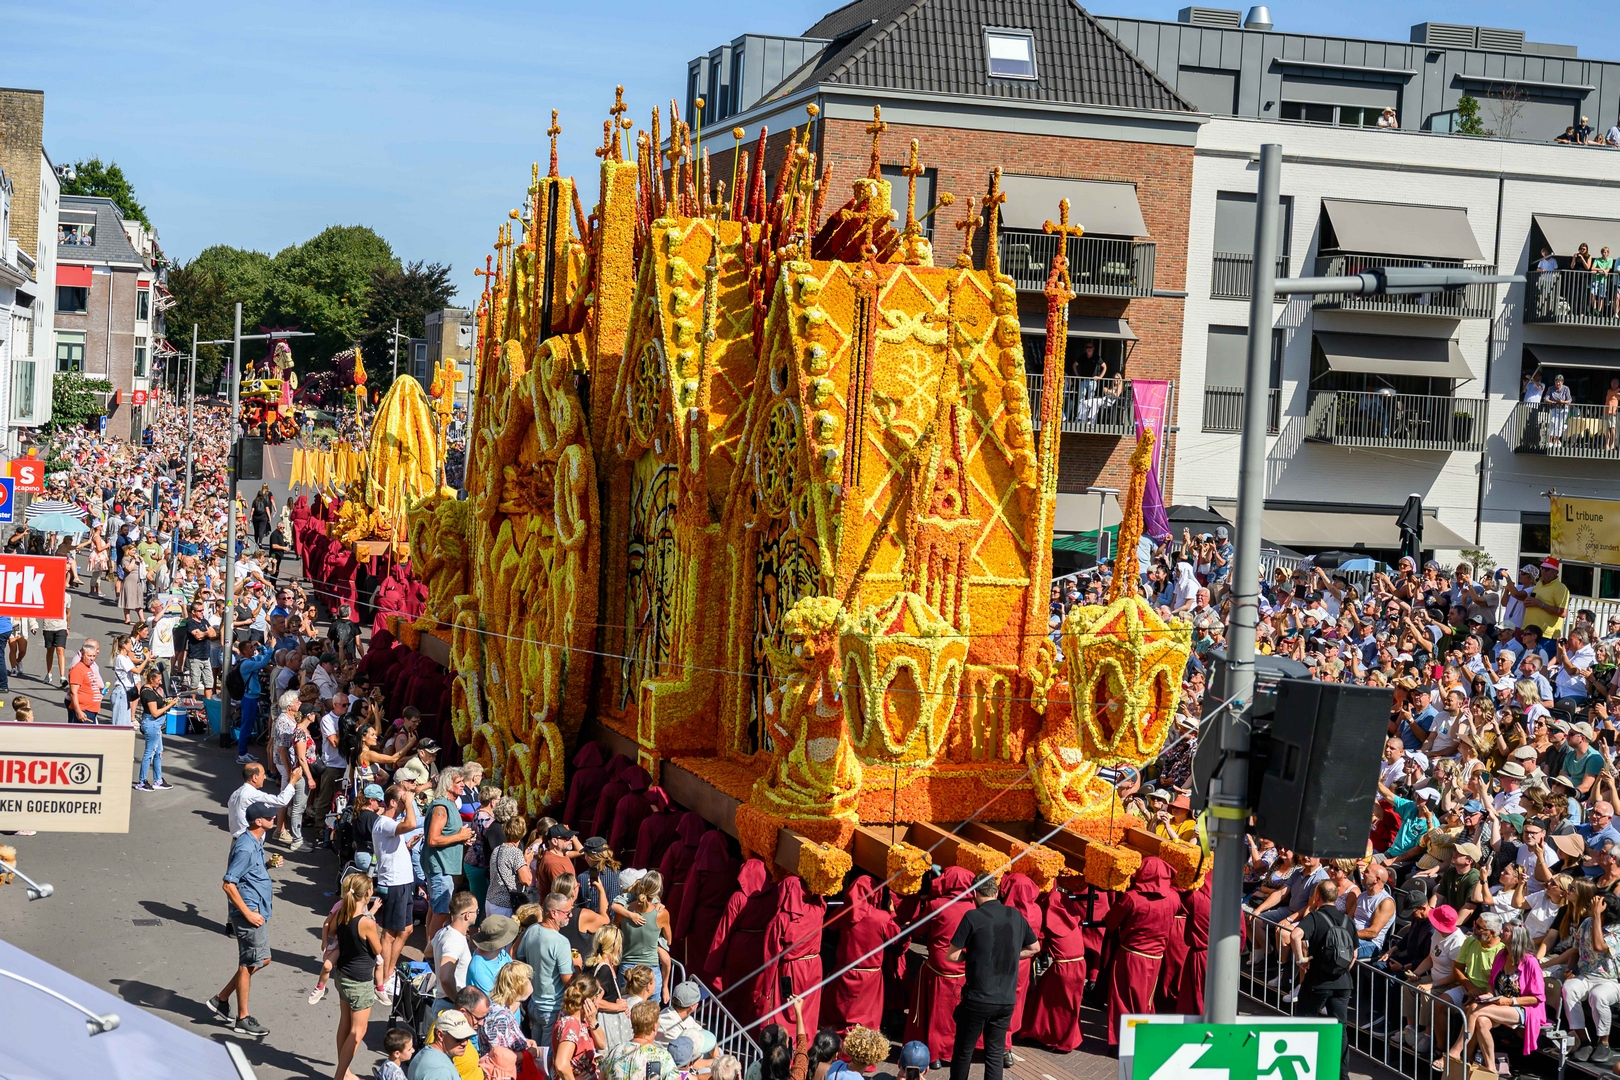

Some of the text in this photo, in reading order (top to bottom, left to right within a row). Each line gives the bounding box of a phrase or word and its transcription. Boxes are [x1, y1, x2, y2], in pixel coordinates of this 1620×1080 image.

[20, 466, 35, 485] S
[1576, 511, 1604, 522] tribune
[1600, 543, 1620, 551] zundert
[27, 800, 102, 814] GOEDKOPER!
